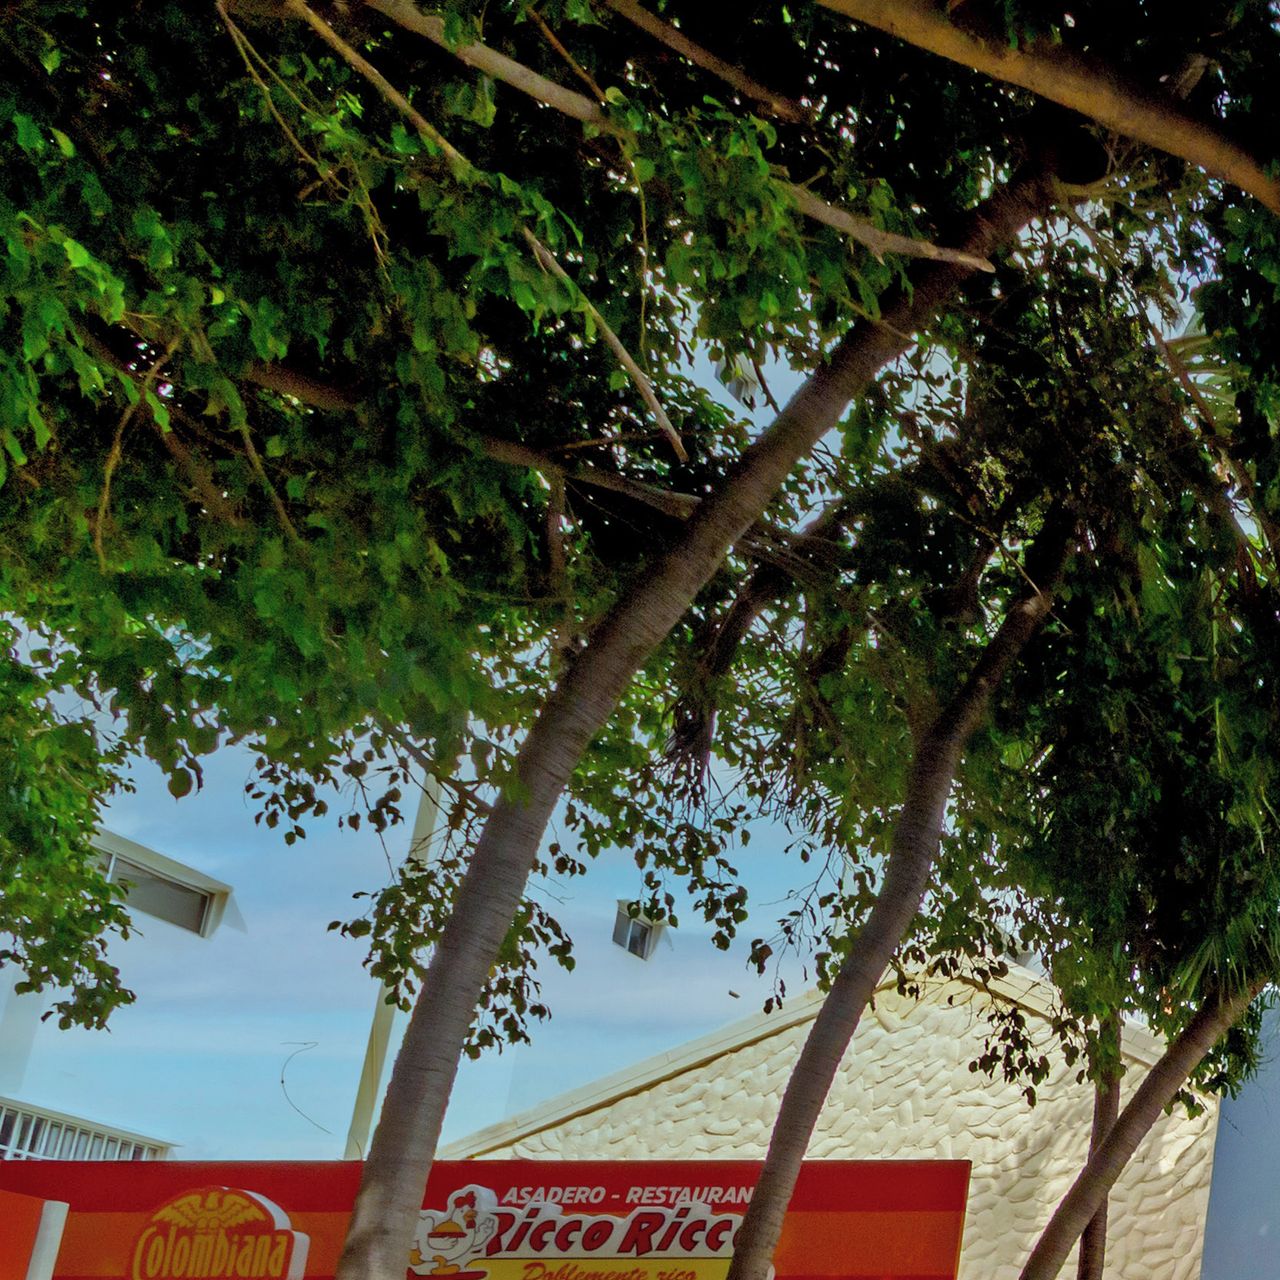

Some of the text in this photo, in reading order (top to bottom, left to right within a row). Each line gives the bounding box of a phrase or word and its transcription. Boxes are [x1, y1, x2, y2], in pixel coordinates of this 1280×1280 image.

[501, 1186, 606, 1204] ASADERO
[625, 1186, 755, 1204] RESTAURAN
[471, 1207, 743, 1257] Ricco Ricc
